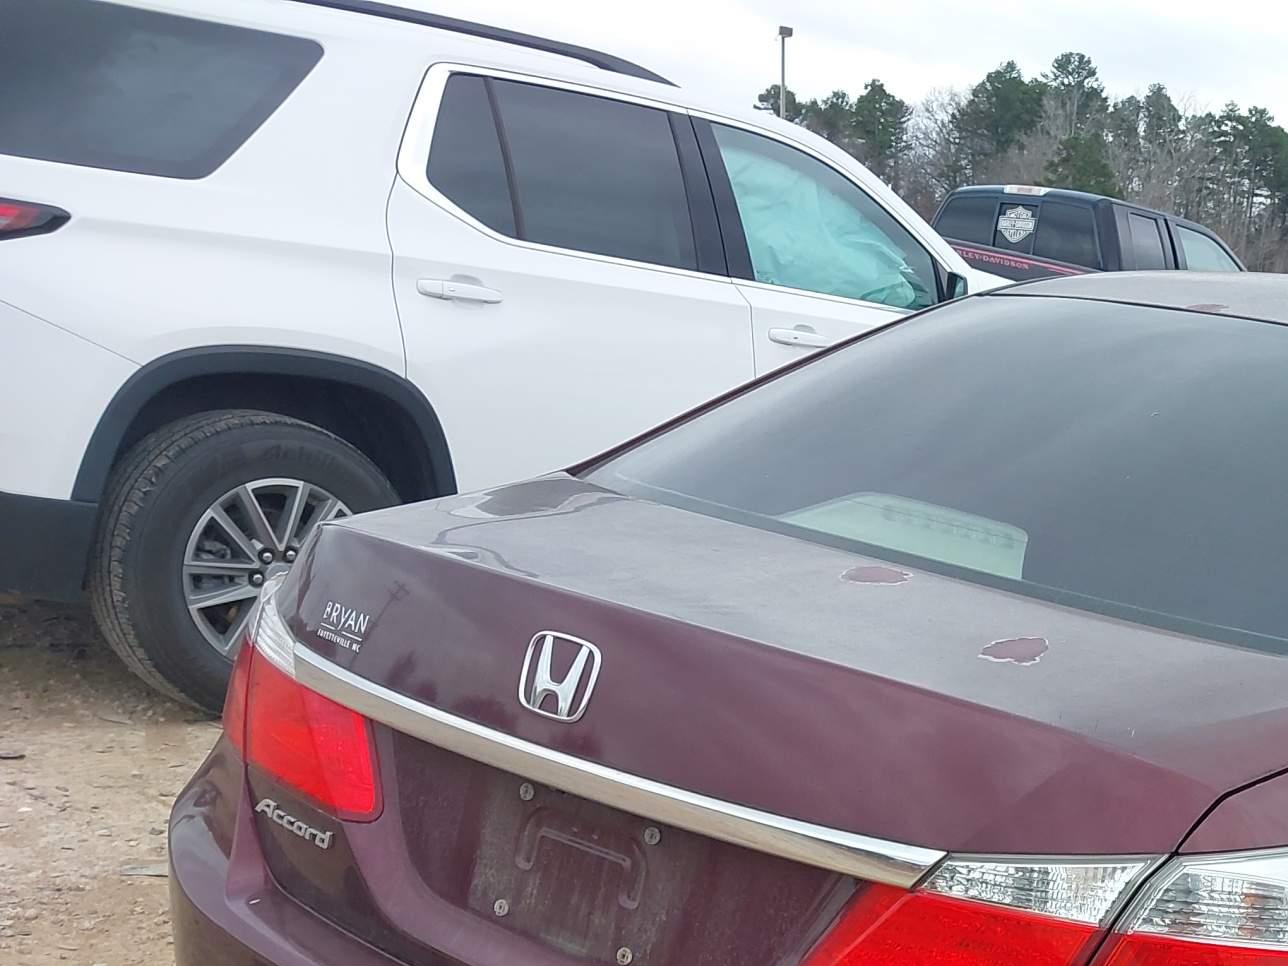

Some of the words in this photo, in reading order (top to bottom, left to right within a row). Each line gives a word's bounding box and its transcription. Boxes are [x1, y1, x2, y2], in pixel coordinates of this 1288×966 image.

[322, 601, 370, 634] BRYAN
[351, 643, 361, 653] NC
[254, 798, 334, 850] Accord
